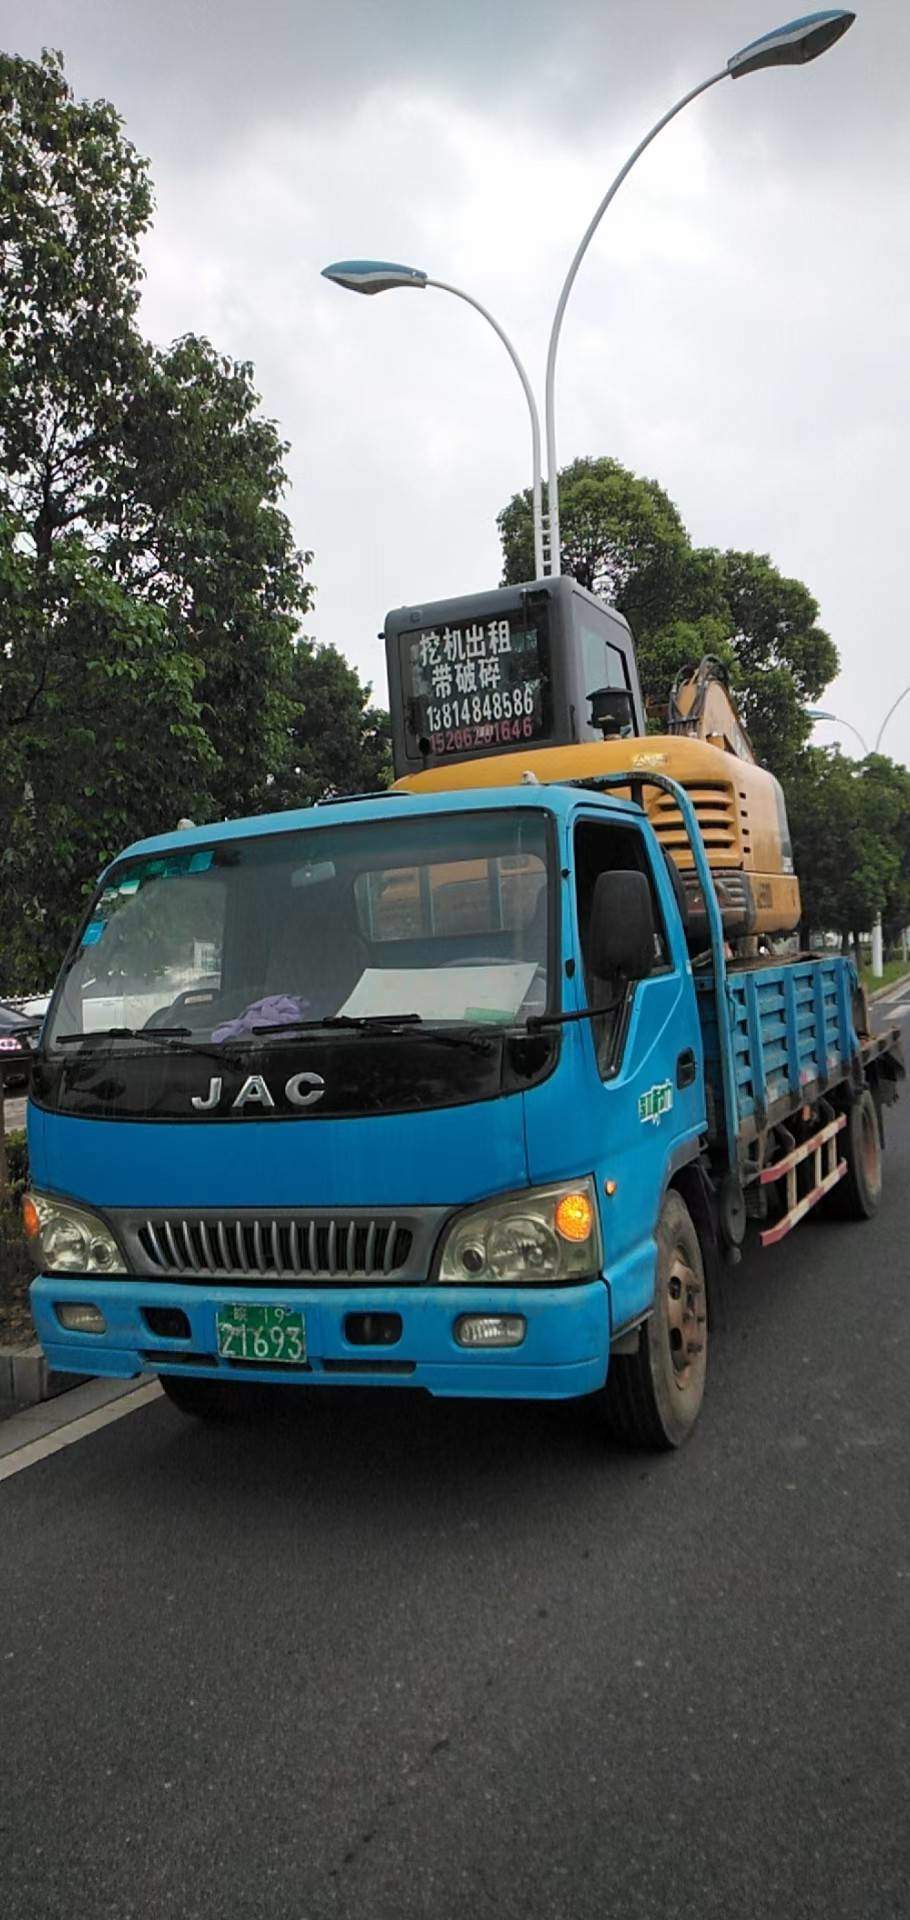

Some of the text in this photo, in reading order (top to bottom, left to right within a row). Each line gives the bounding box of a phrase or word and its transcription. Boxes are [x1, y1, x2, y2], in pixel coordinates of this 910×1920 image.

[419, 620, 512, 667] 挖机出租
[432, 656, 501, 699] 带破碎
[426, 687, 534, 732] 13814848586
[191, 1072, 326, 1110] JAC
[220, 1323, 302, 1359] 21693
